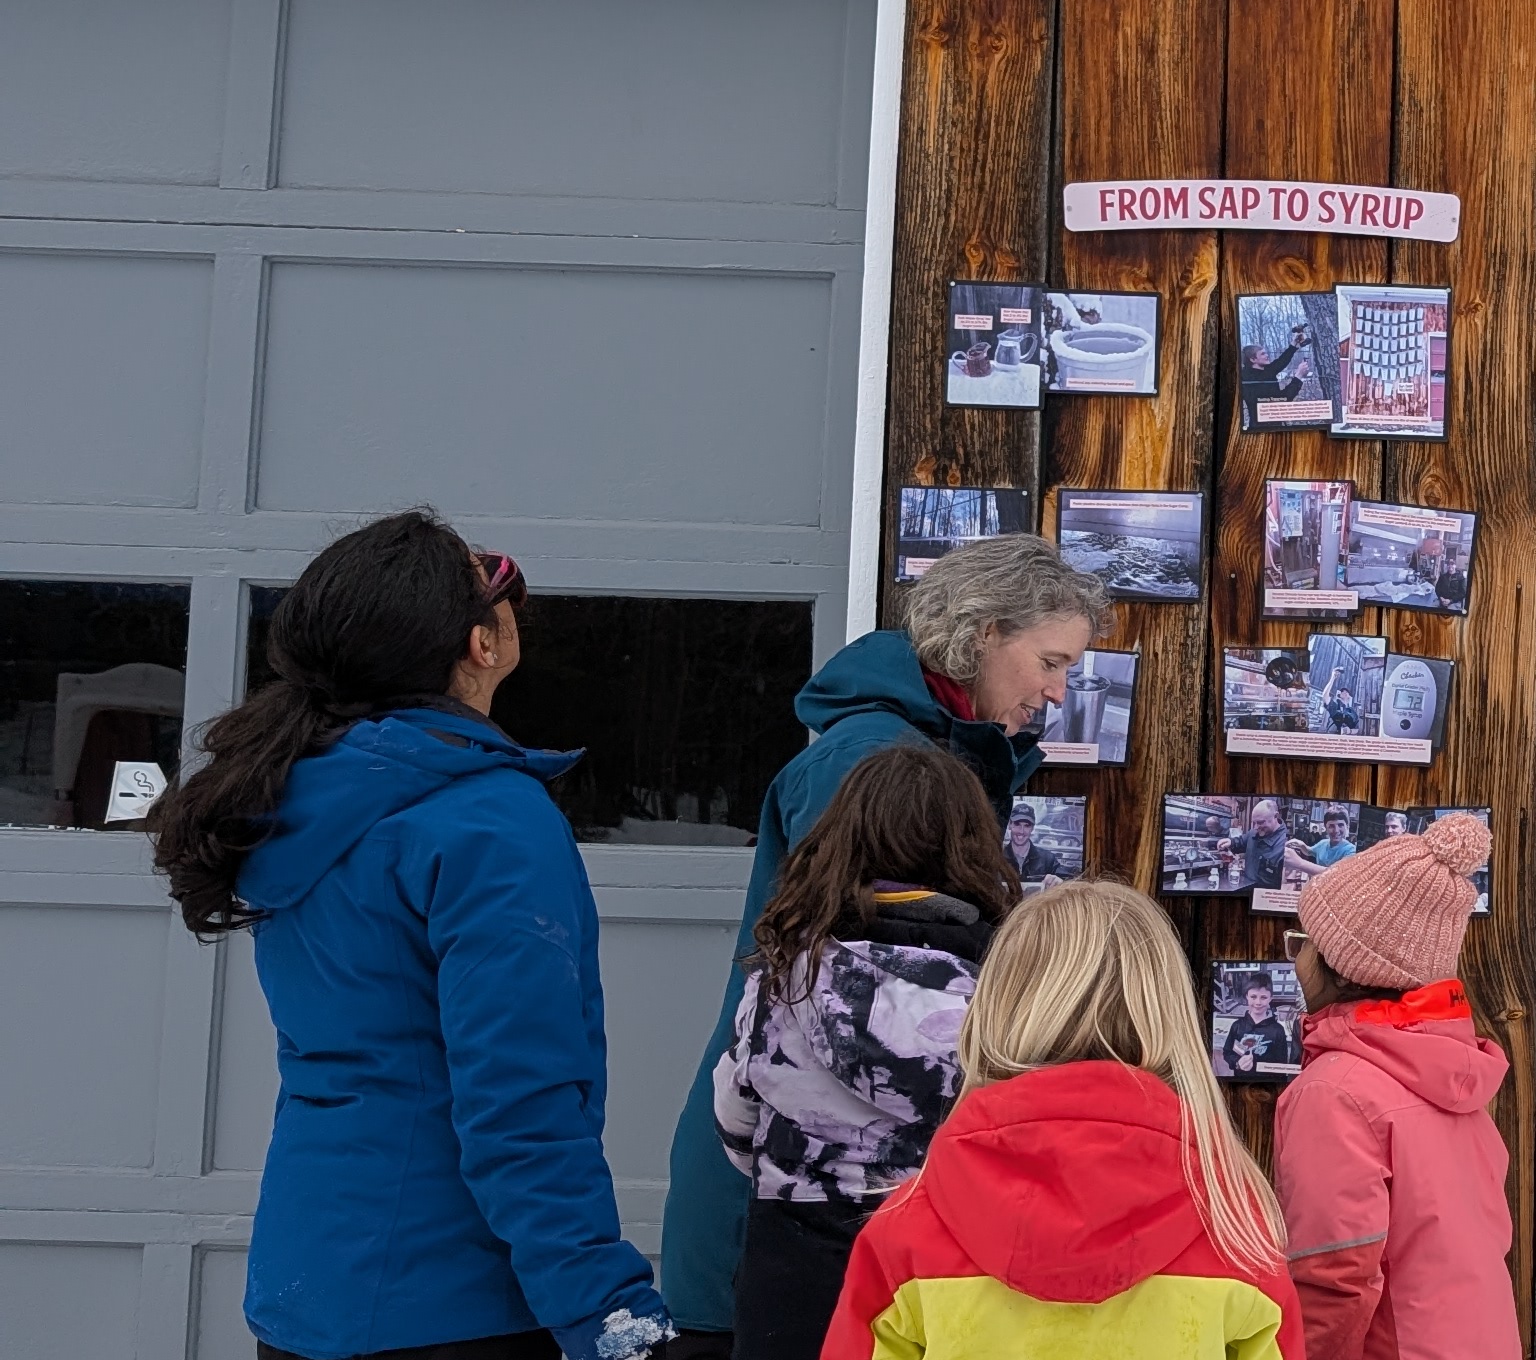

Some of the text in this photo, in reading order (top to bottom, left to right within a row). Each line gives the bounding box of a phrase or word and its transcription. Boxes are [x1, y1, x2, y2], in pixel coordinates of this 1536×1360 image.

[1098, 186, 1424, 230] FROM SAP TO SYRUP
